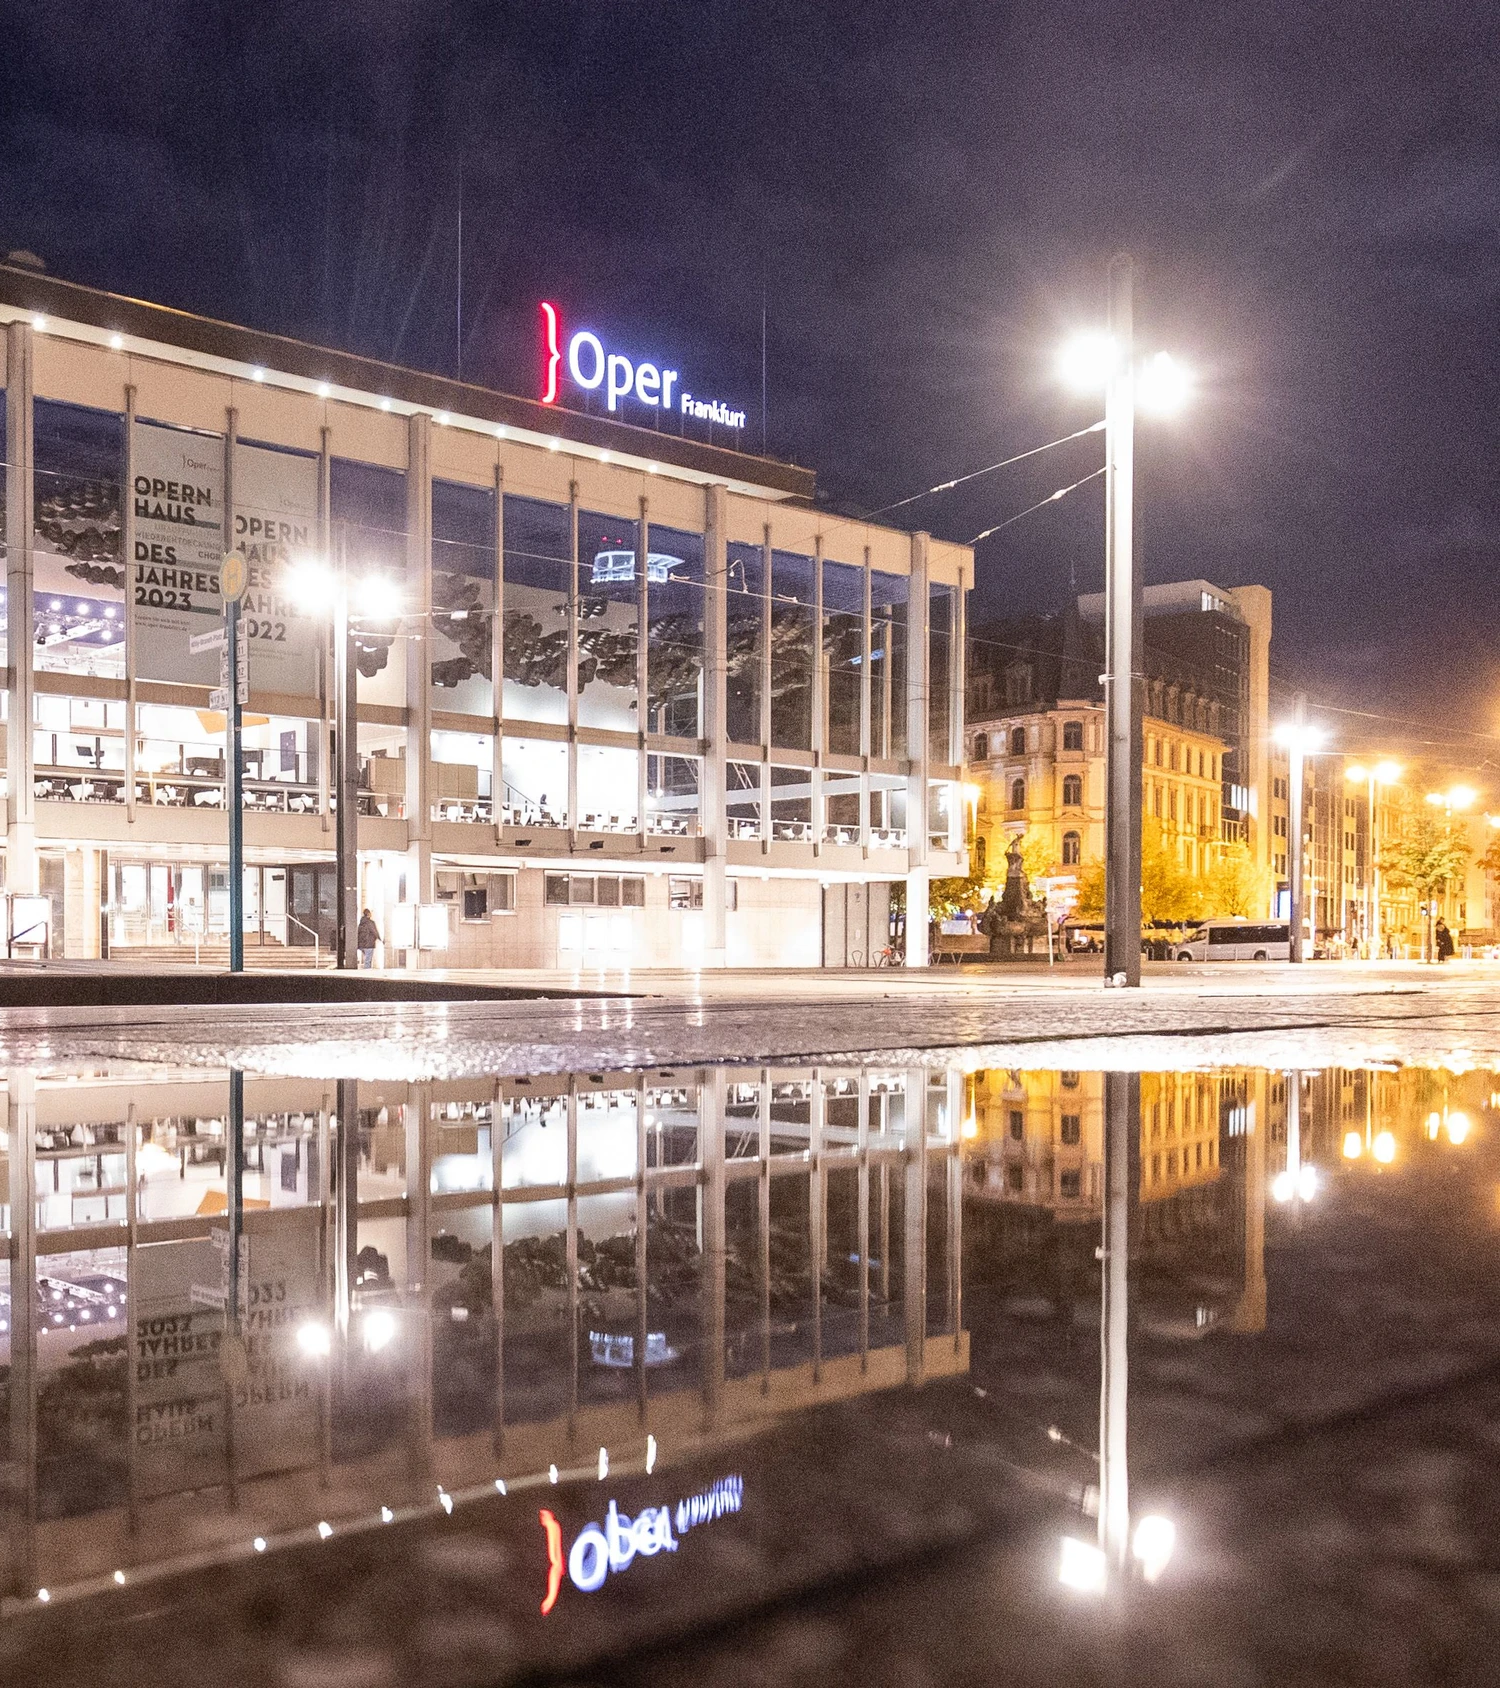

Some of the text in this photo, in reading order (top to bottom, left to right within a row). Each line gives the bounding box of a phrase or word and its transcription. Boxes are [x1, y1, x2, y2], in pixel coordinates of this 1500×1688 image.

[569, 331, 746, 428] Oper Frankfurt
[135, 475, 211, 508] OPERN
[135, 498, 196, 525] HAUS
[135, 541, 177, 565] DES
[135, 564, 220, 594] JAHRES
[248, 568, 272, 589] ES
[135, 586, 192, 611] 2023
[248, 618, 287, 642] 022
